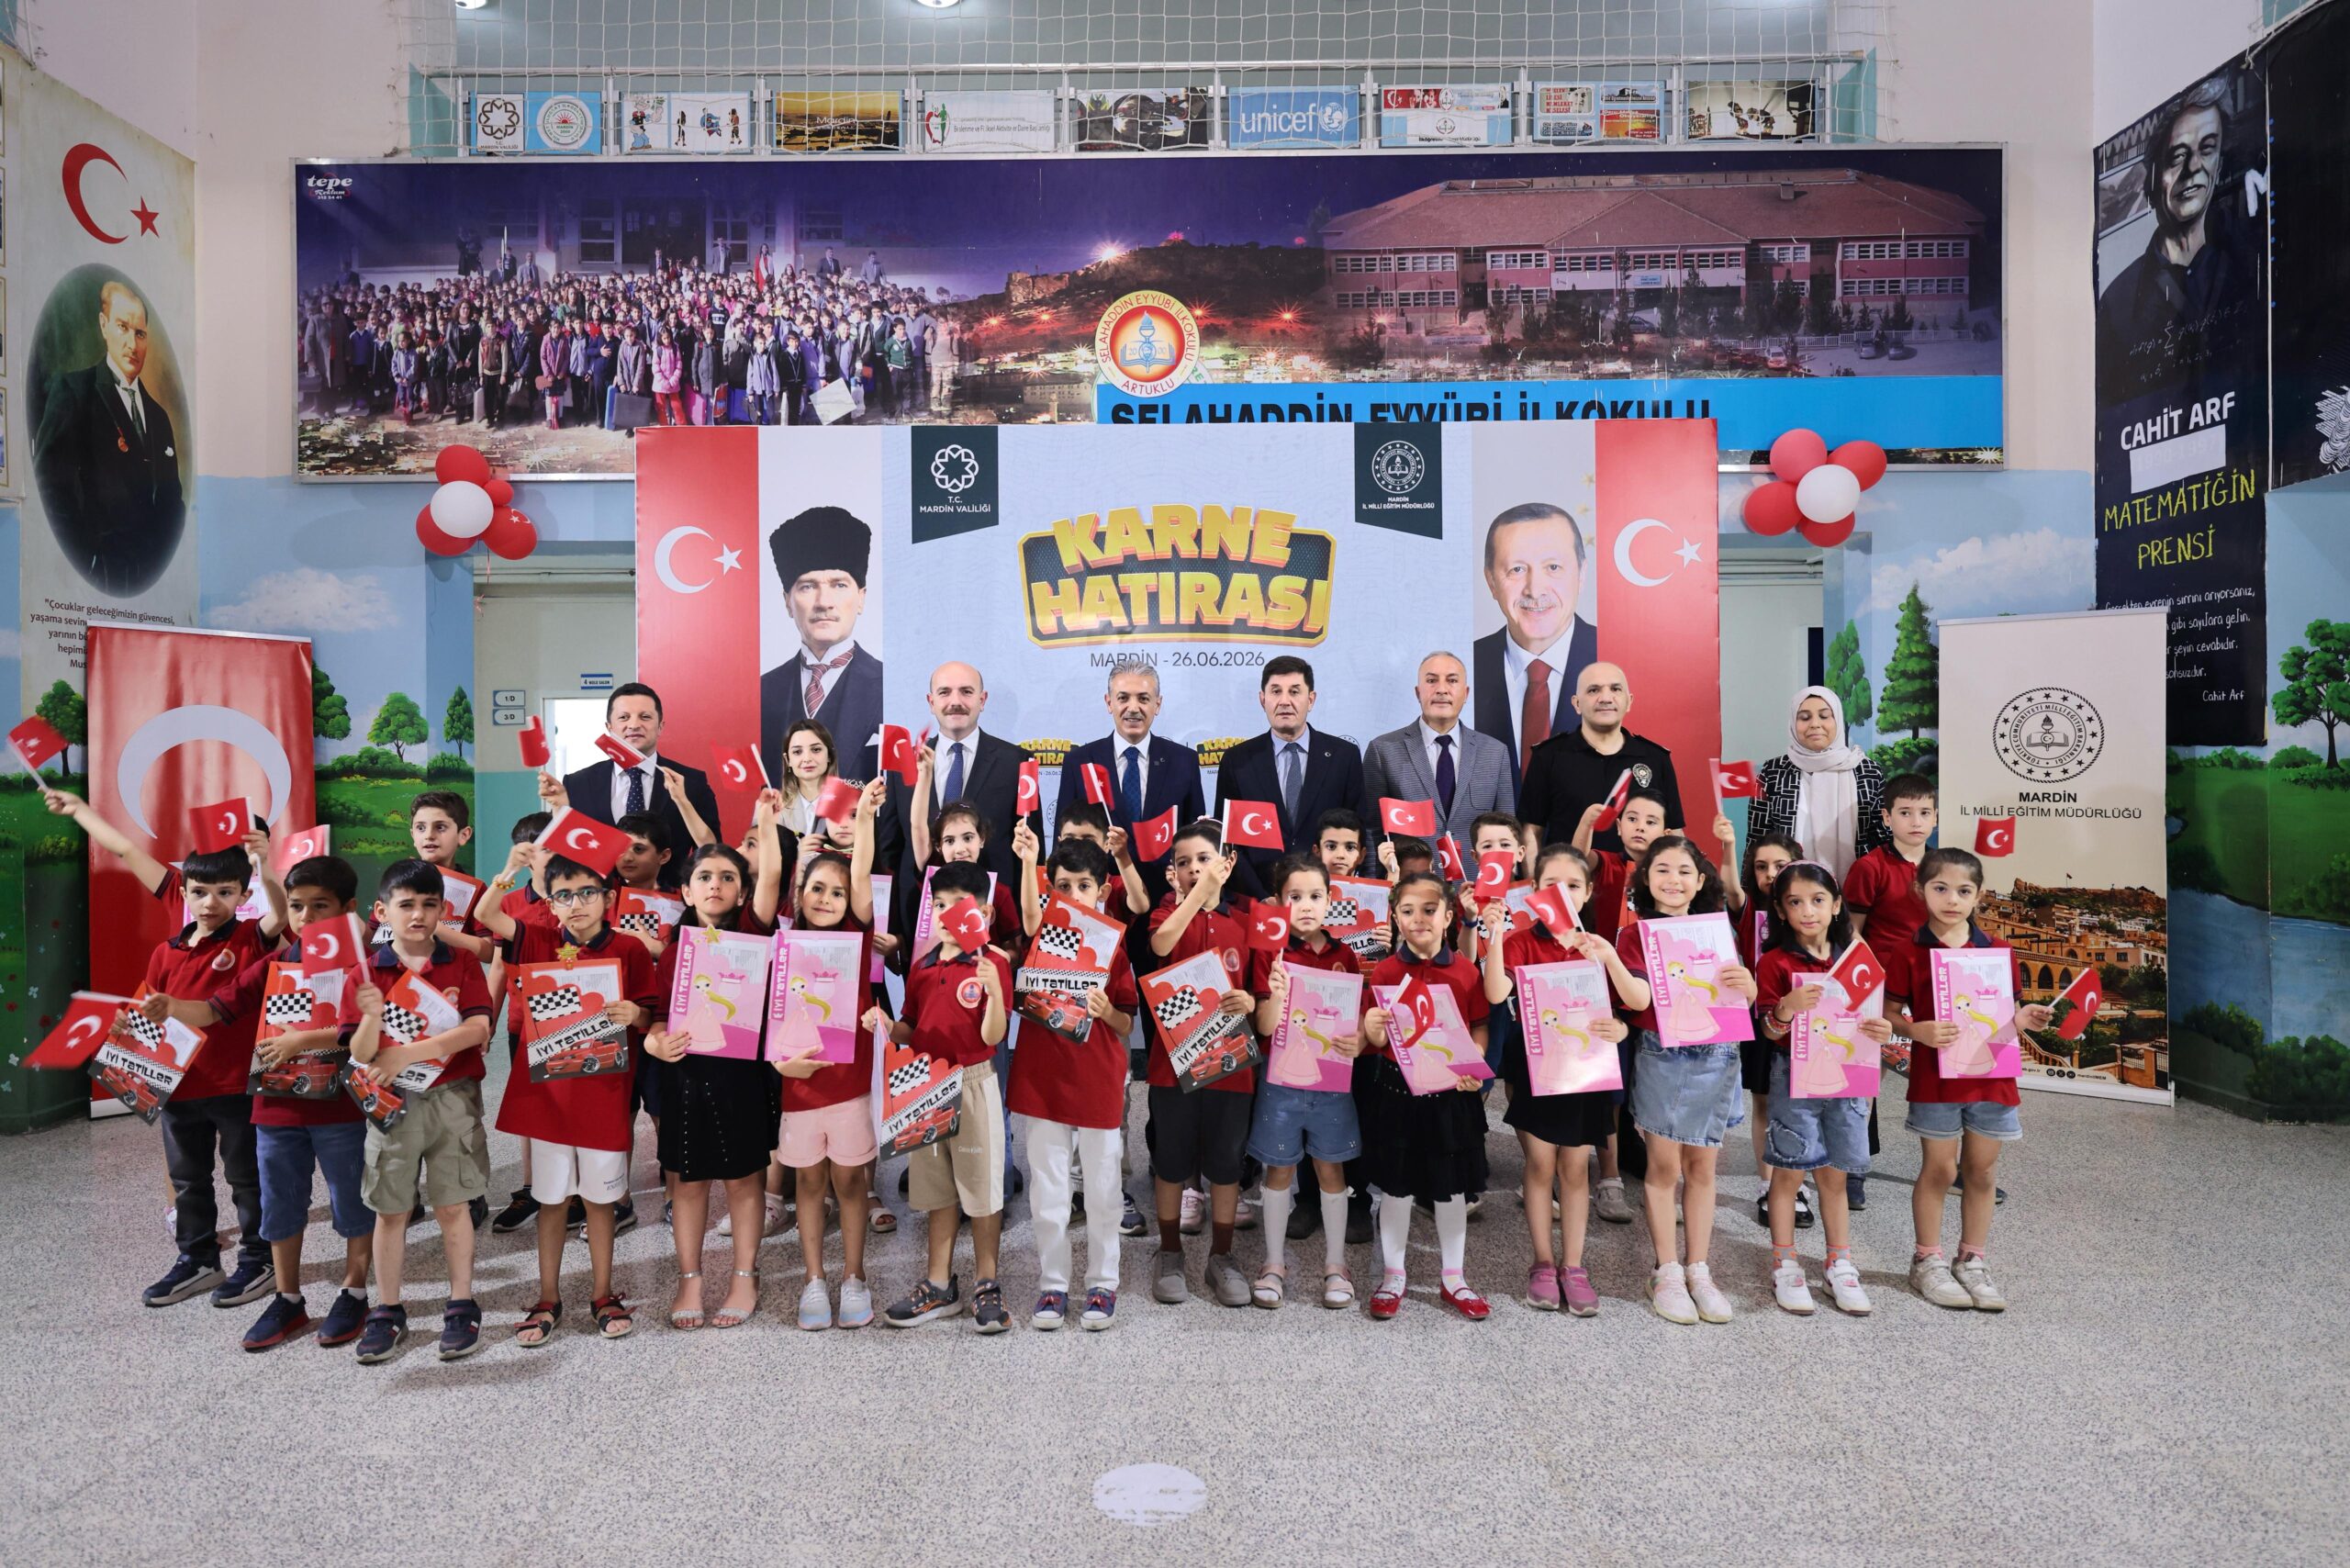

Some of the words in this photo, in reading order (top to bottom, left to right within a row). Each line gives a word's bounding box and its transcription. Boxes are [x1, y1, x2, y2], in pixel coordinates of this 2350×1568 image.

[1241, 103, 1316, 133] unicef
[307, 174, 353, 189] tepe
[1121, 378, 1175, 395] ARTUKLU
[2121, 408, 2183, 451] CAHİT
[2188, 391, 2235, 431] ARF
[920, 504, 954, 513] MARDİN
[957, 504, 990, 513] VALİLİĞİ
[2104, 468, 2255, 532] MATEMATİĞİN
[1051, 503, 1297, 575] KARNE
[2138, 523, 2216, 570] PRENSİ
[1031, 571, 1330, 635] HATIRASI
[30, 613, 62, 624] yaşama
[86, 606, 138, 620] geleceğimizin
[139, 610, 175, 625] güvencesi,
[2171, 616, 2186, 634] gibi
[2188, 612, 2223, 631] sayılara
[2225, 608, 2251, 629] gelin.
[48, 630, 77, 640] yarının
[2174, 641, 2195, 657] şeyin
[2197, 637, 2238, 653] cevabıdır.
[1172, 651, 1265, 666] 26.06.2026
[2203, 690, 2227, 702] Cahit
[2229, 689, 2245, 700] Arf
[2019, 790, 2077, 803] MARDİN
[1961, 804, 1970, 815] İL
[2008, 806, 2051, 817] EĞİTİM
[2054, 807, 2143, 819] MÜDÜRLÜĞÜ
